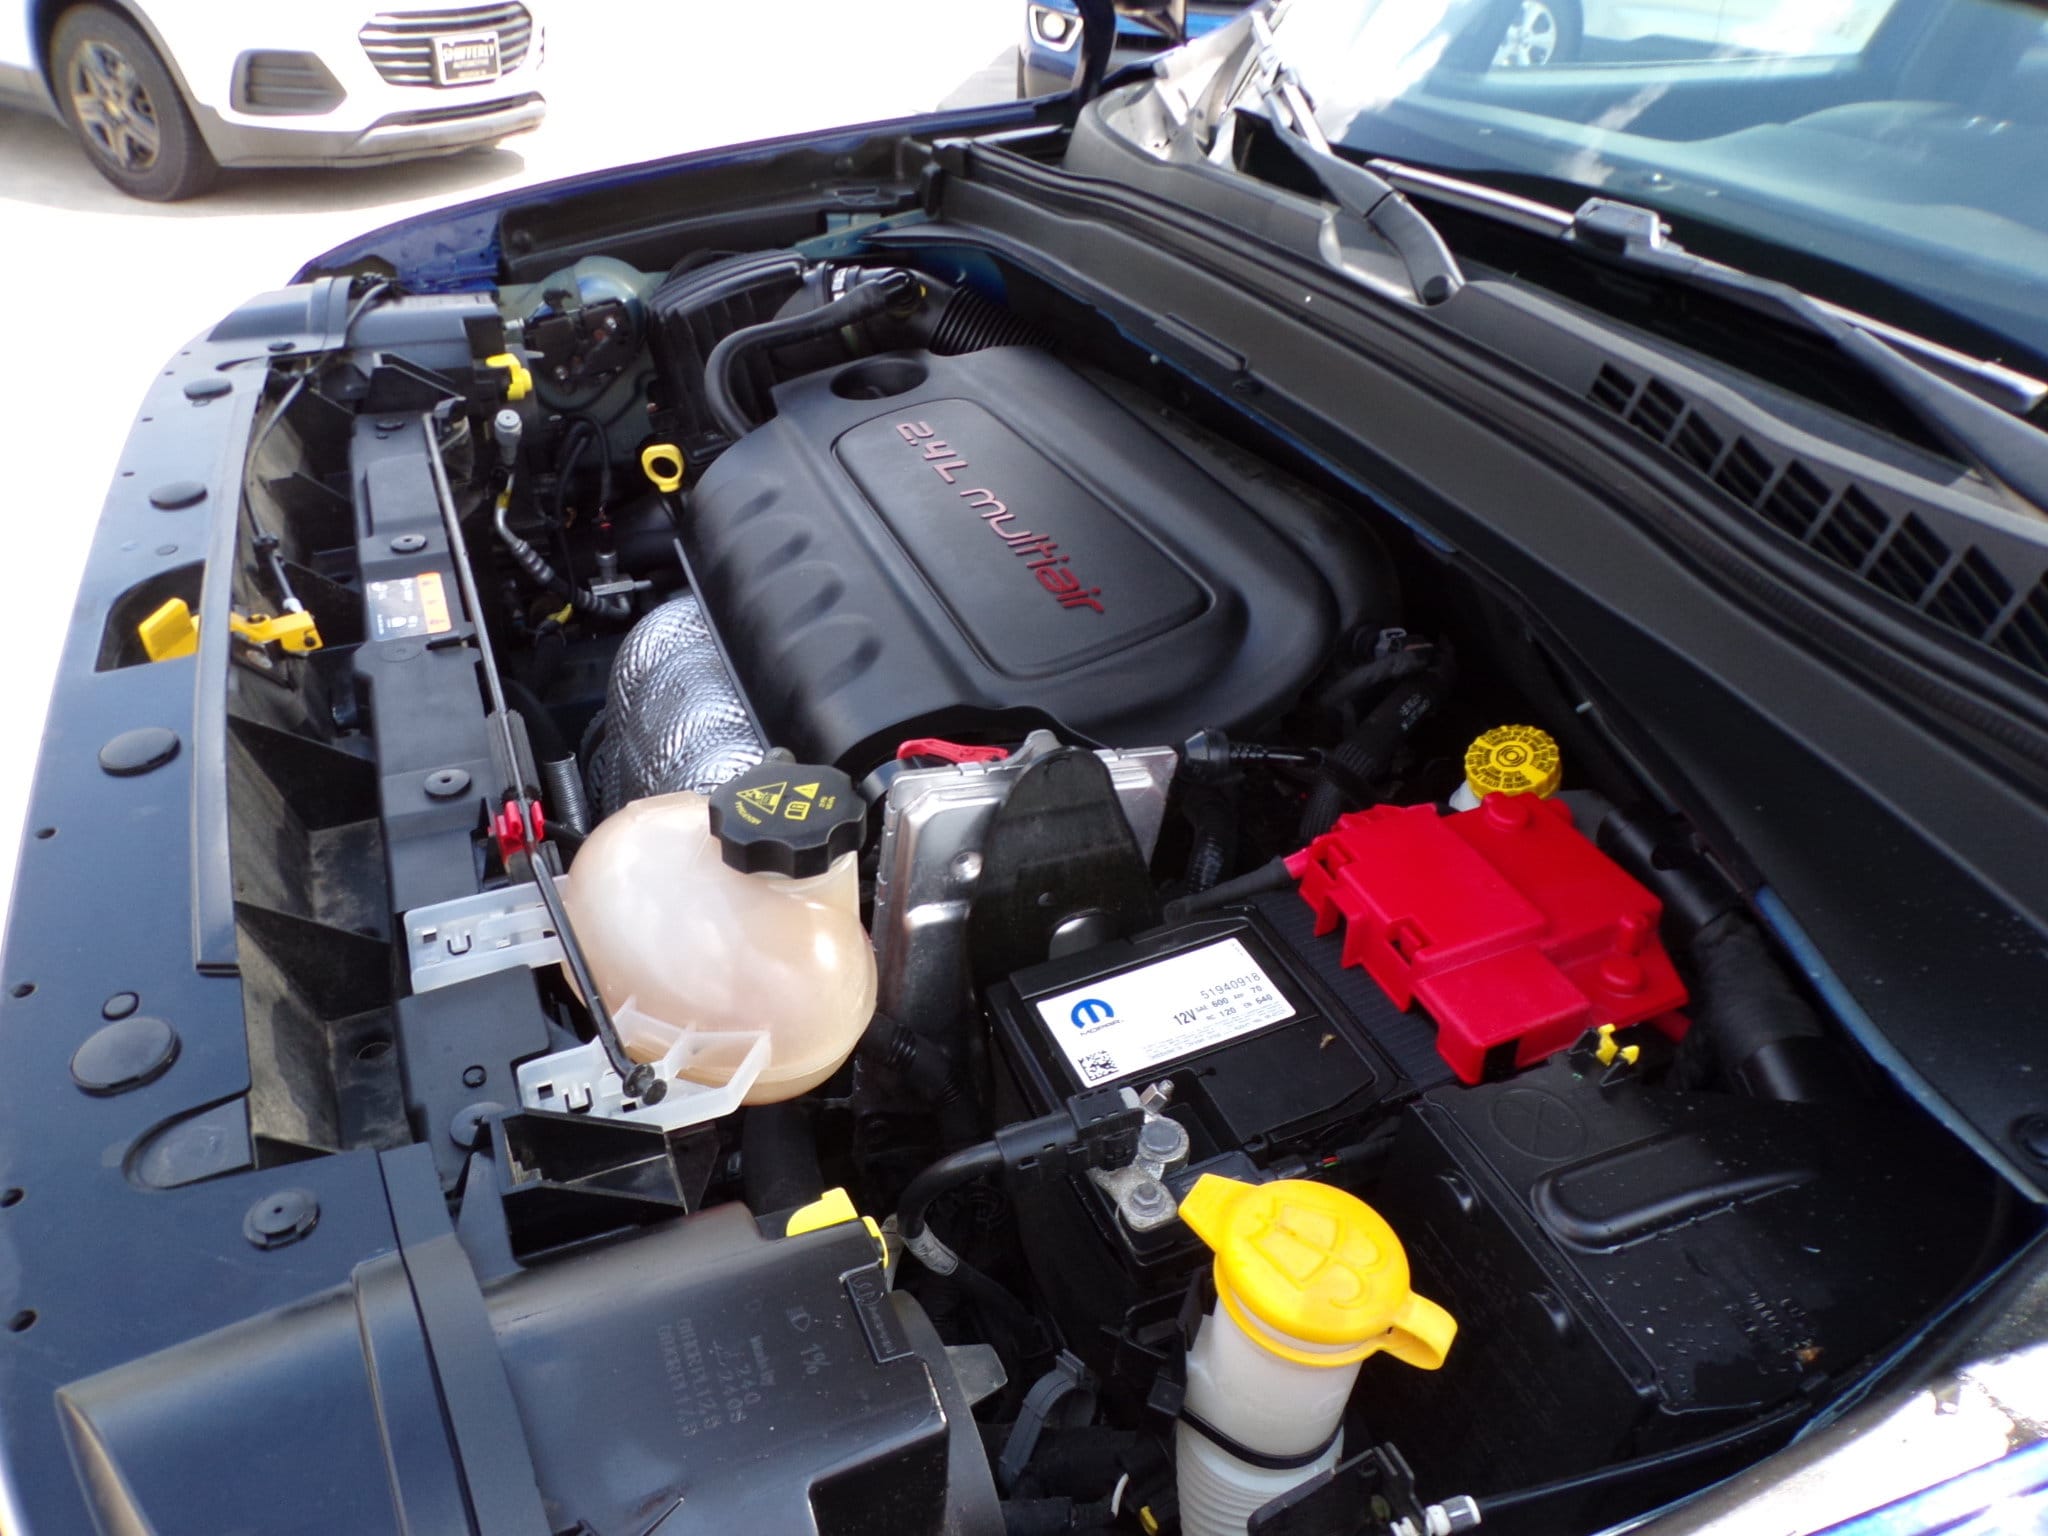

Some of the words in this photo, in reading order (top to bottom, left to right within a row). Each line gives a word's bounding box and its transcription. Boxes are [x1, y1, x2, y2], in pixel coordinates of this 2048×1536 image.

[896, 421, 968, 484] 2.4L
[960, 488, 1104, 614] multiair
[1200, 972, 1261, 1000] 51940918
[1173, 1009, 1197, 1026] 12V
[1211, 997, 1229, 1008] 600
[1250, 985, 1263, 994] 70
[1219, 1007, 1236, 1017] 120
